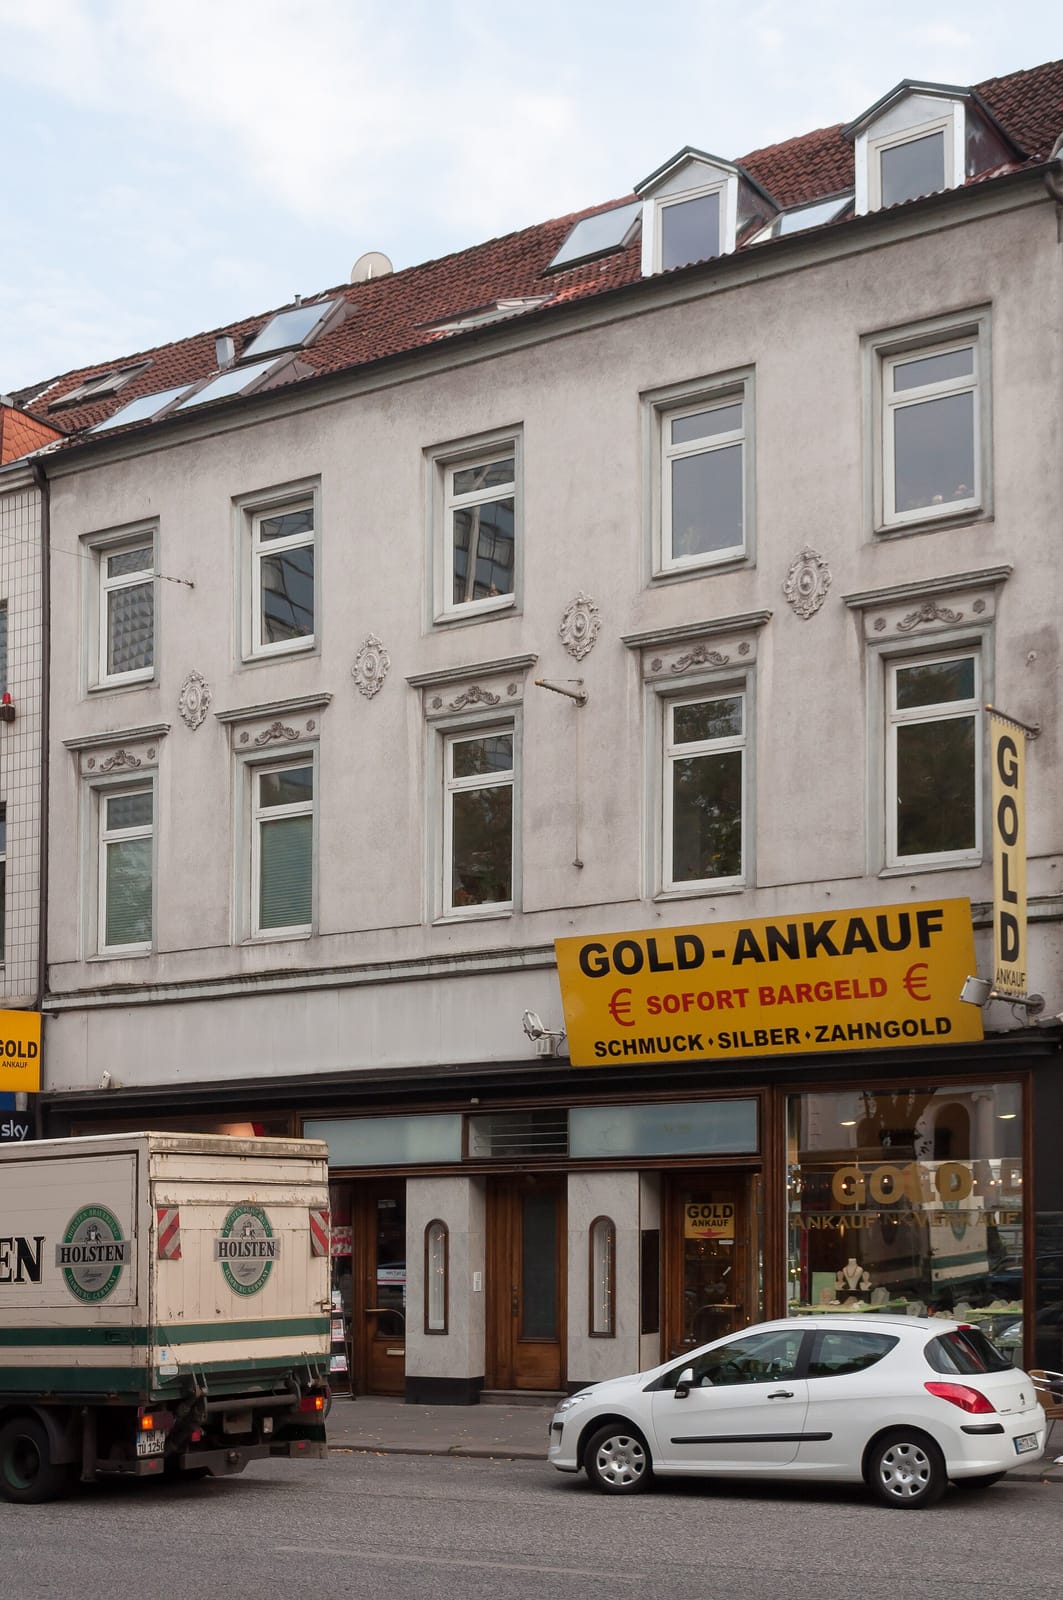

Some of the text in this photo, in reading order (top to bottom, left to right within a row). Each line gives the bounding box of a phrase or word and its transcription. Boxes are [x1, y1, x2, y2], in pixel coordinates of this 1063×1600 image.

[997, 735, 1020, 963] GOLD
[995, 967, 1027, 988] ANKAUF
[646, 988, 749, 1015] SOFORT
[758, 977, 888, 1006] BARGELD
[594, 1017, 952, 1057] SCHMUCK SILBER ZAHNGOLD
[2, 1060, 28, 1069] ANKAUF
[1, 1119, 29, 1141] sky
[831, 1162, 973, 1206] GOLD
[687, 1204, 733, 1219] GOLD
[791, 1213, 877, 1230] ANKAUF
[691, 1218, 729, 1227] ANKAUF
[61, 1244, 125, 1264] HOLSTEN
[218, 1241, 276, 1258] HOLSTEN
